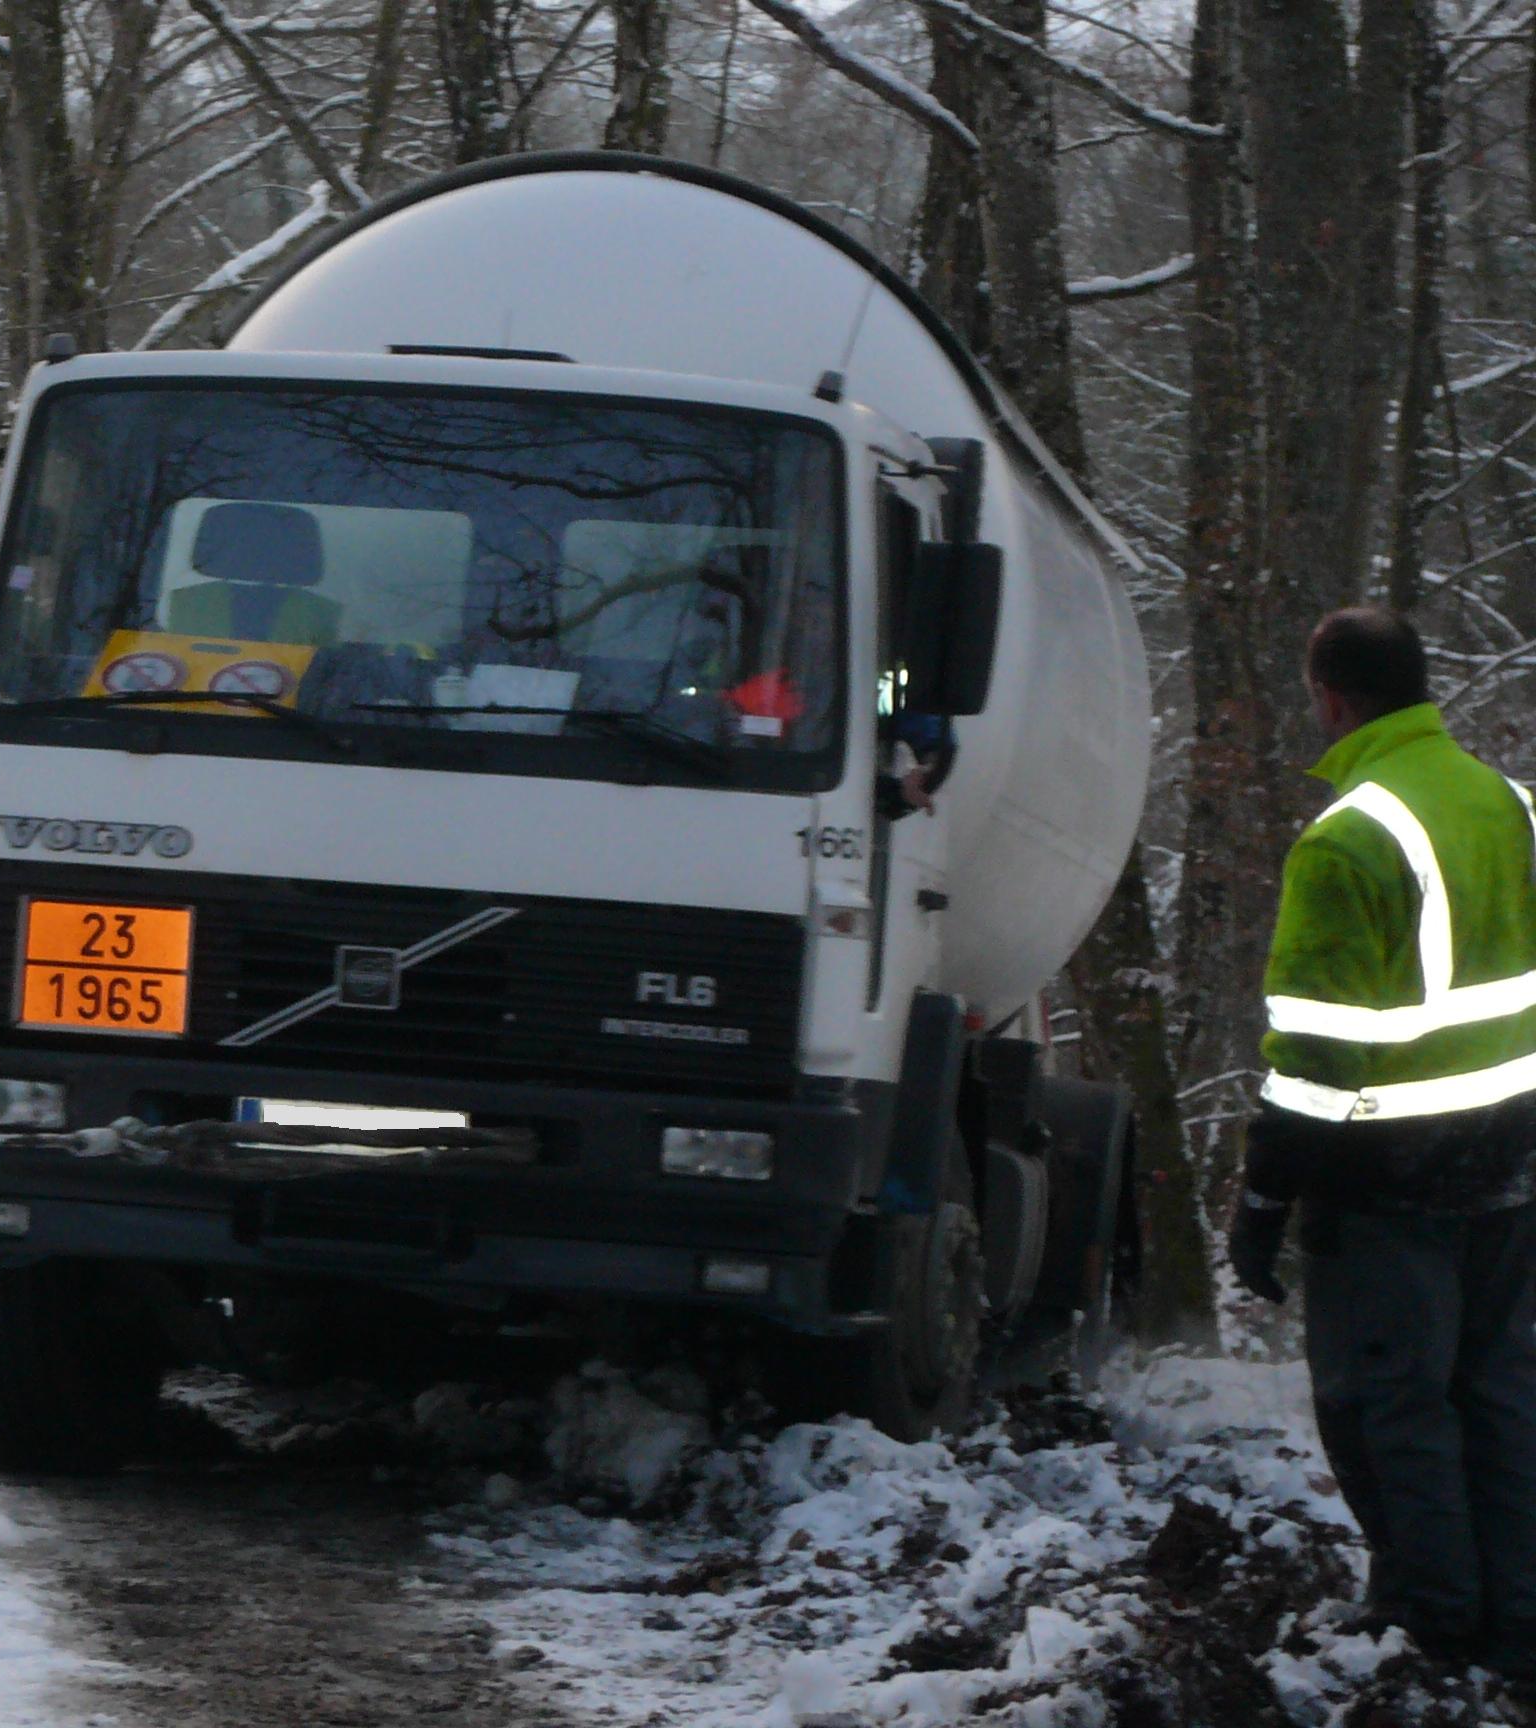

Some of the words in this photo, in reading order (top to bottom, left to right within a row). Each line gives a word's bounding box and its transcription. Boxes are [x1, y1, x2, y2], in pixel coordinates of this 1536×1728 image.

[80, 912, 136, 959] 23
[48, 973, 163, 1025] 1965
[636, 971, 717, 1008] FL6
